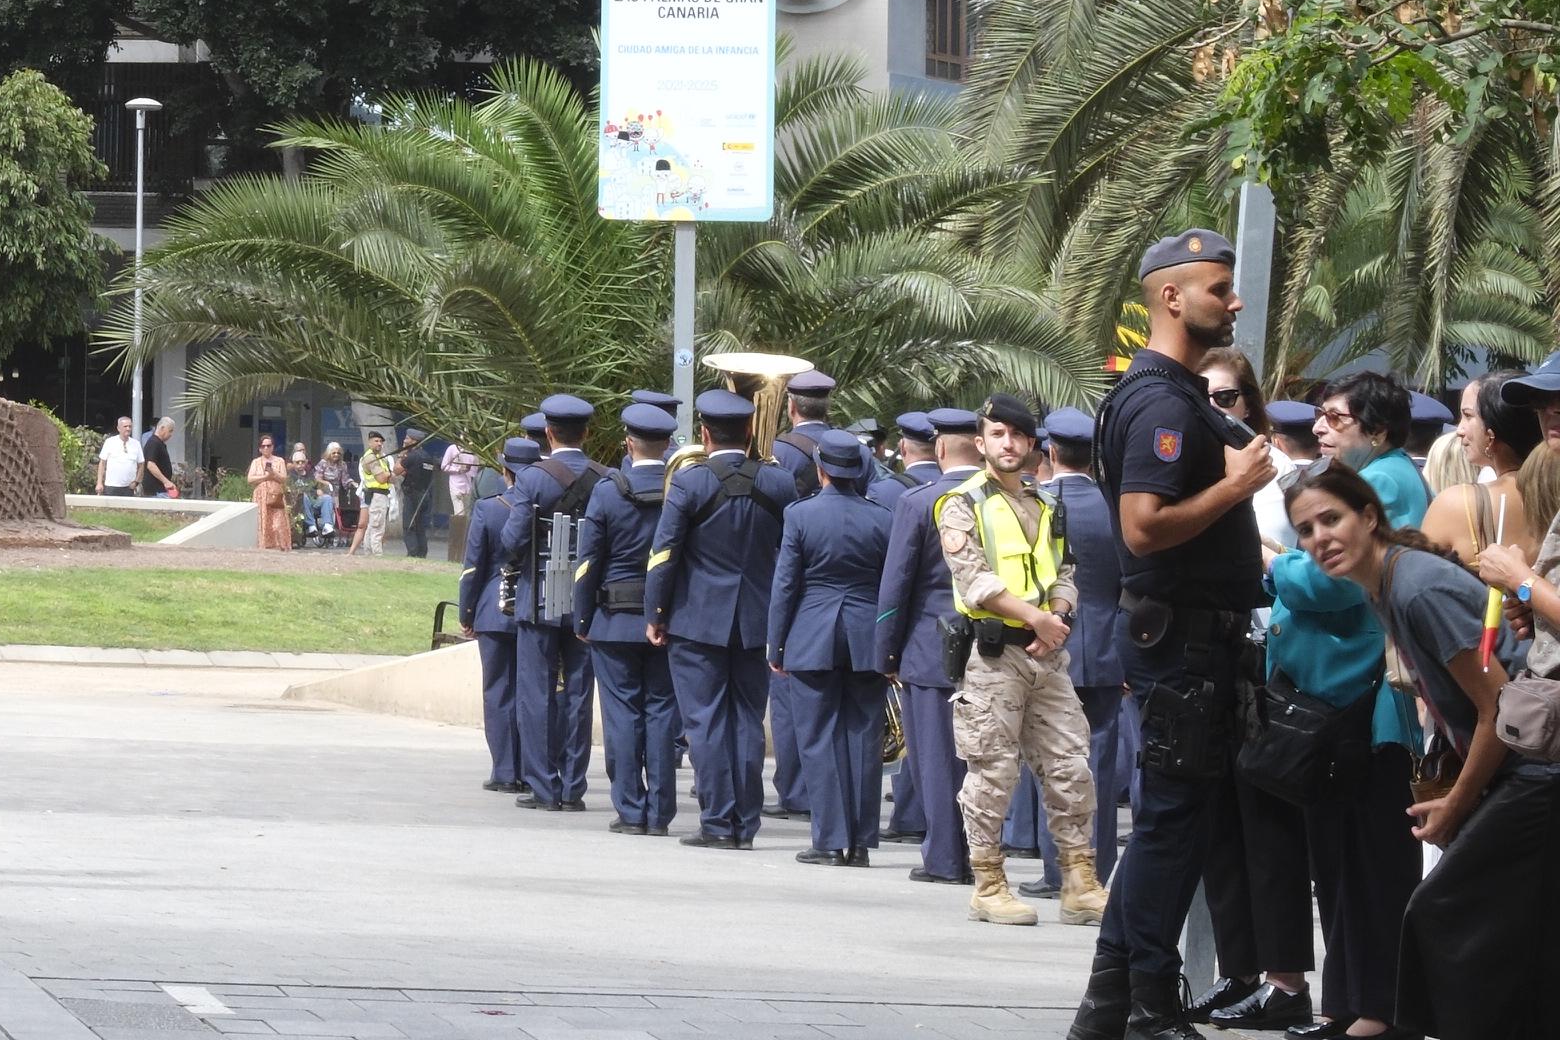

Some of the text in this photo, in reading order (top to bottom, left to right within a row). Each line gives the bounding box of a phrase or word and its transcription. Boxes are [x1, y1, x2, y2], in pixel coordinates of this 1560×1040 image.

[657, 6, 720, 19] CANARIA
[617, 44, 759, 56] CIUDAD AMIGA DE LA INFANCIA
